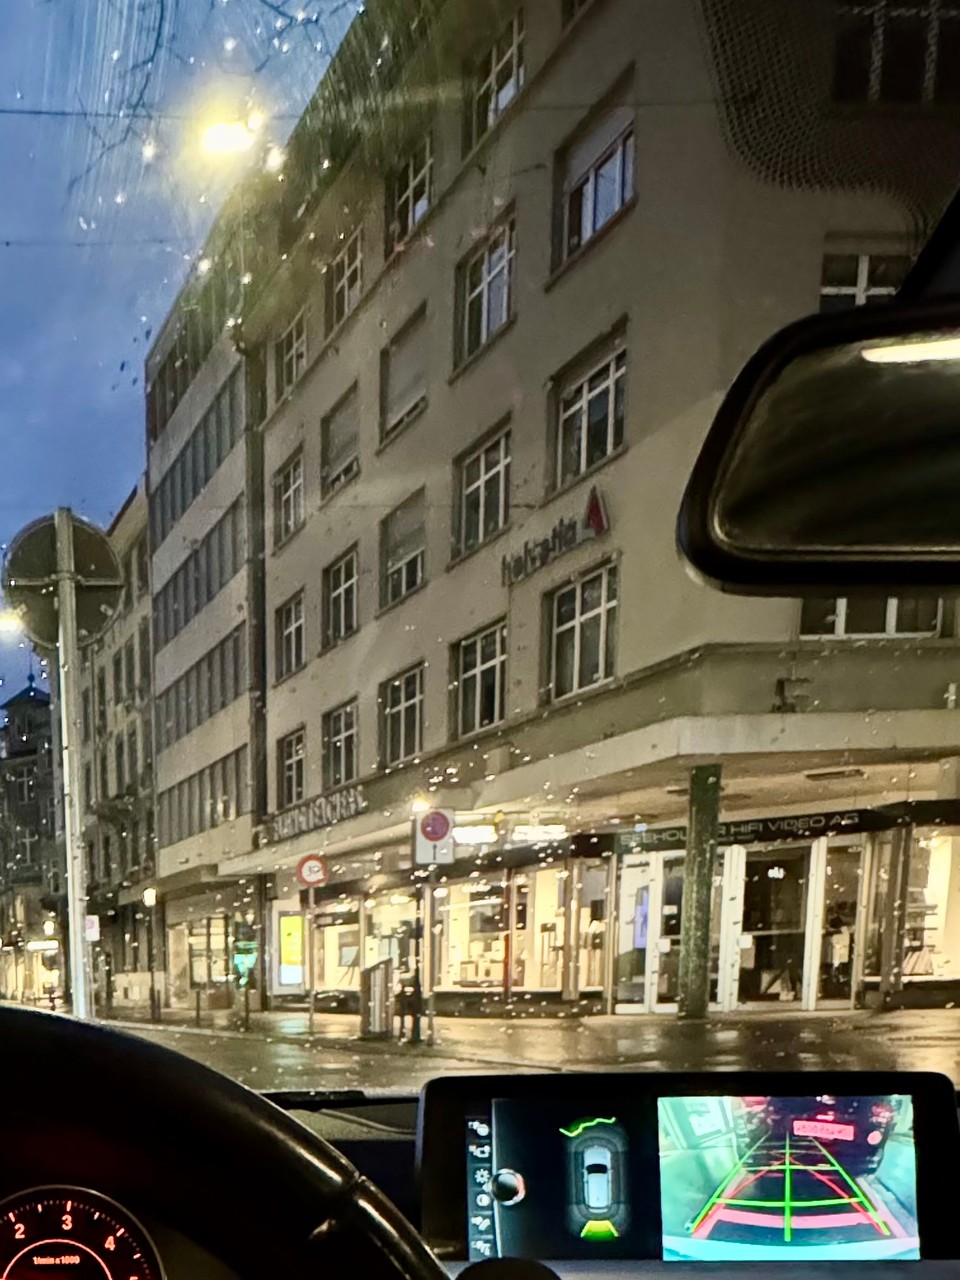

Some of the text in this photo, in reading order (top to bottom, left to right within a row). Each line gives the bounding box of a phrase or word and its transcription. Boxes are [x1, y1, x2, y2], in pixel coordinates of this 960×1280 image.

[730, 822, 763, 836] HIFI
[767, 817, 826, 832] VIDEO
[829, 813, 859, 826] AG
[61, 1214, 73, 1230] 3
[14, 1223, 25, 1239] 2
[104, 1236, 116, 1251] 4
